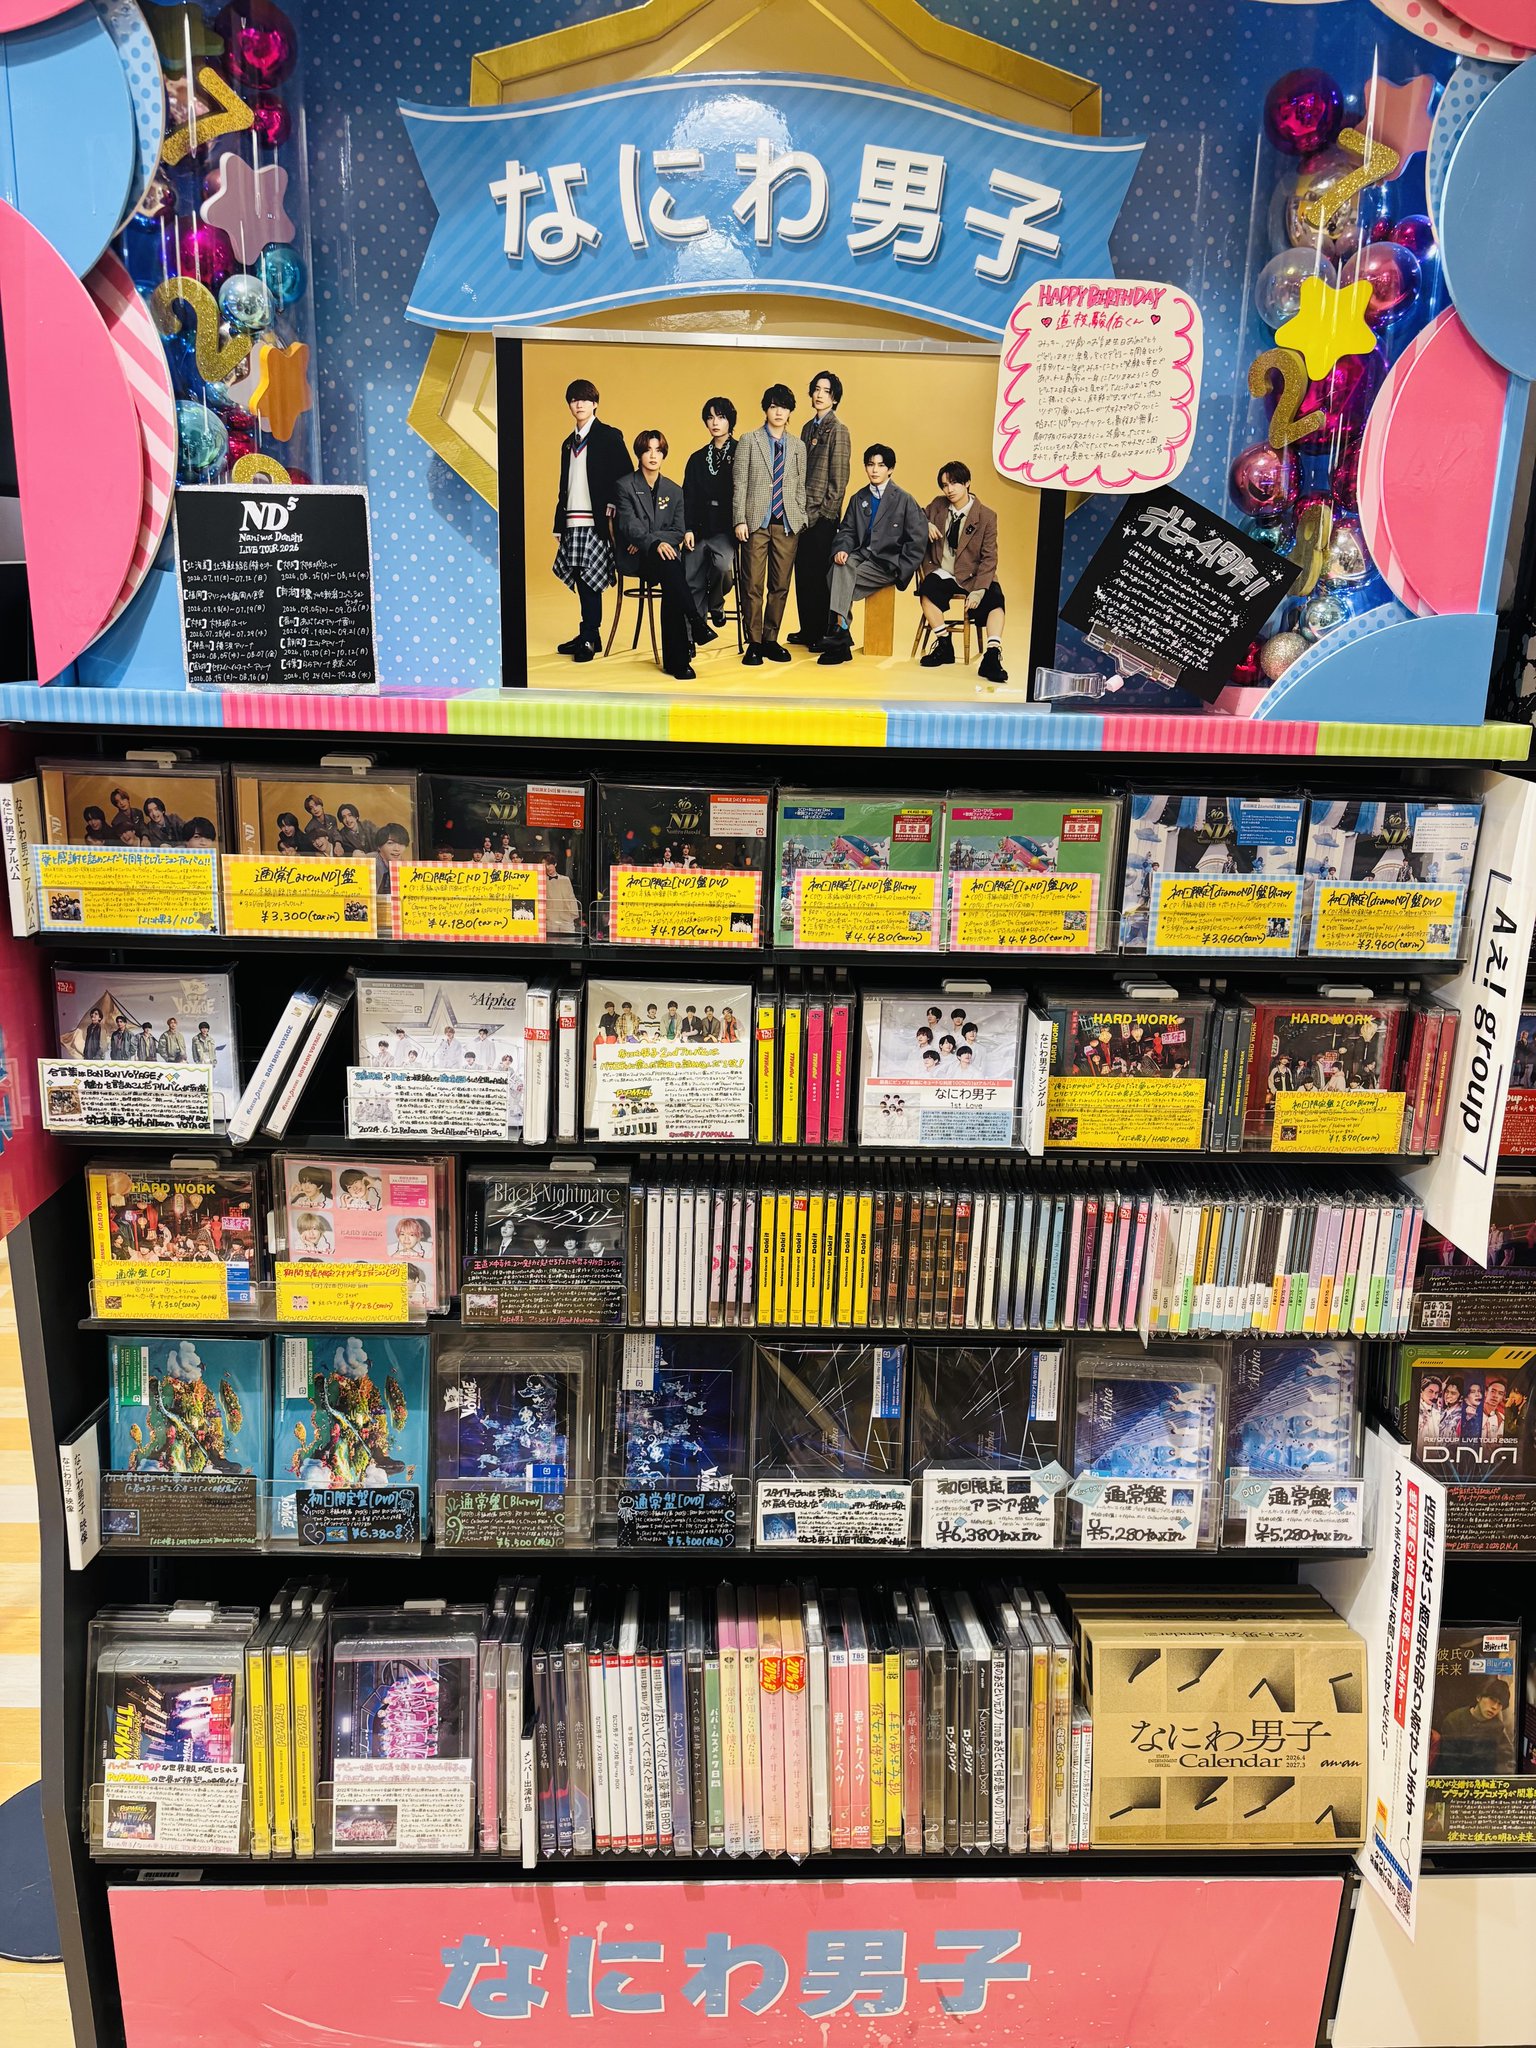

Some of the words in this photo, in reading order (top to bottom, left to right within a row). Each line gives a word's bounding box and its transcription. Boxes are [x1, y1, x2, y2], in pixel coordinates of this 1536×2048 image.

[489, 138, 1062, 283] なにわ男子
[1038, 285, 1087, 307] HAPPY
[1086, 285, 1167, 310] BIRTHDAY
[1056, 310, 1144, 331] 道枝駿佑くん
[274, 531, 303, 542] Danshi
[8, 846, 21, 881] アルバム
[14, 797, 30, 872] なにわ男子
[23, 877, 37, 931] アルバム
[1093, 1013, 1133, 1025] HARD
[1136, 1014, 1179, 1025] WORK
[1291, 1013, 1327, 1024] HARD
[1333, 1014, 1375, 1025] WORK
[264, 1062, 276, 1077] BON
[272, 1048, 282, 1065] BON
[278, 1025, 293, 1050] VOYAGE
[1038, 1033, 1048, 1074] なにわ男子
[1460, 1004, 1497, 1134] group
[935, 1088, 997, 1100] なにわ男子
[1036, 1077, 1047, 1108] シングル
[131, 1183, 170, 1193] HARD
[174, 1183, 216, 1194] WORK
[494, 1182, 538, 1202] Black
[542, 1183, 620, 1203] Nightmare
[116, 1268, 148, 1279] 通常盤
[459, 1378, 478, 1419] VOYAGE
[74, 1453, 86, 1514] なにわ男子
[936, 1477, 1005, 1495] 初回限定
[1105, 1484, 1167, 1505] 通常盤
[1242, 1485, 1261, 1498] DVD
[461, 1493, 501, 1511] 通常盤
[635, 1492, 678, 1510] 通常盤
[678, 1493, 705, 1509] [DVD]
[970, 1495, 1042, 1515] アジア盤
[1268, 1485, 1332, 1508] 通常盤
[1436, 1648, 1474, 1660] 彼氏の
[1405, 1494, 1439, 1841] 店頭にない商品お取り寄せします！
[1436, 1663, 1462, 1675] 未来
[993, 1660, 1005, 1720] 僕のあざとい元カノ
[993, 1722, 1005, 1737] from
[1130, 1719, 1331, 1752] なにわ男子
[834, 1712, 845, 1788] 君がトクベツ
[854, 1710, 864, 1787] 君がトクベツ
[871, 1703, 884, 1787] 彼女お借りします
[887, 1711, 901, 1797] 彼女お借りします
[946, 1726, 956, 1772] ロンダリング
[962, 1729, 973, 1777] ロンダリング
[1179, 1753, 1282, 1768] Calendar
[978, 1774, 989, 1796] DOOR
[993, 1739, 1005, 1809] あざとくて何が悪いの?
[993, 1811, 1005, 1843] DVD-BOX
[1448, 1831, 1534, 1842] 彼女と彼氏の明るい未来
[438, 1929, 1031, 2019] なにわ男子
